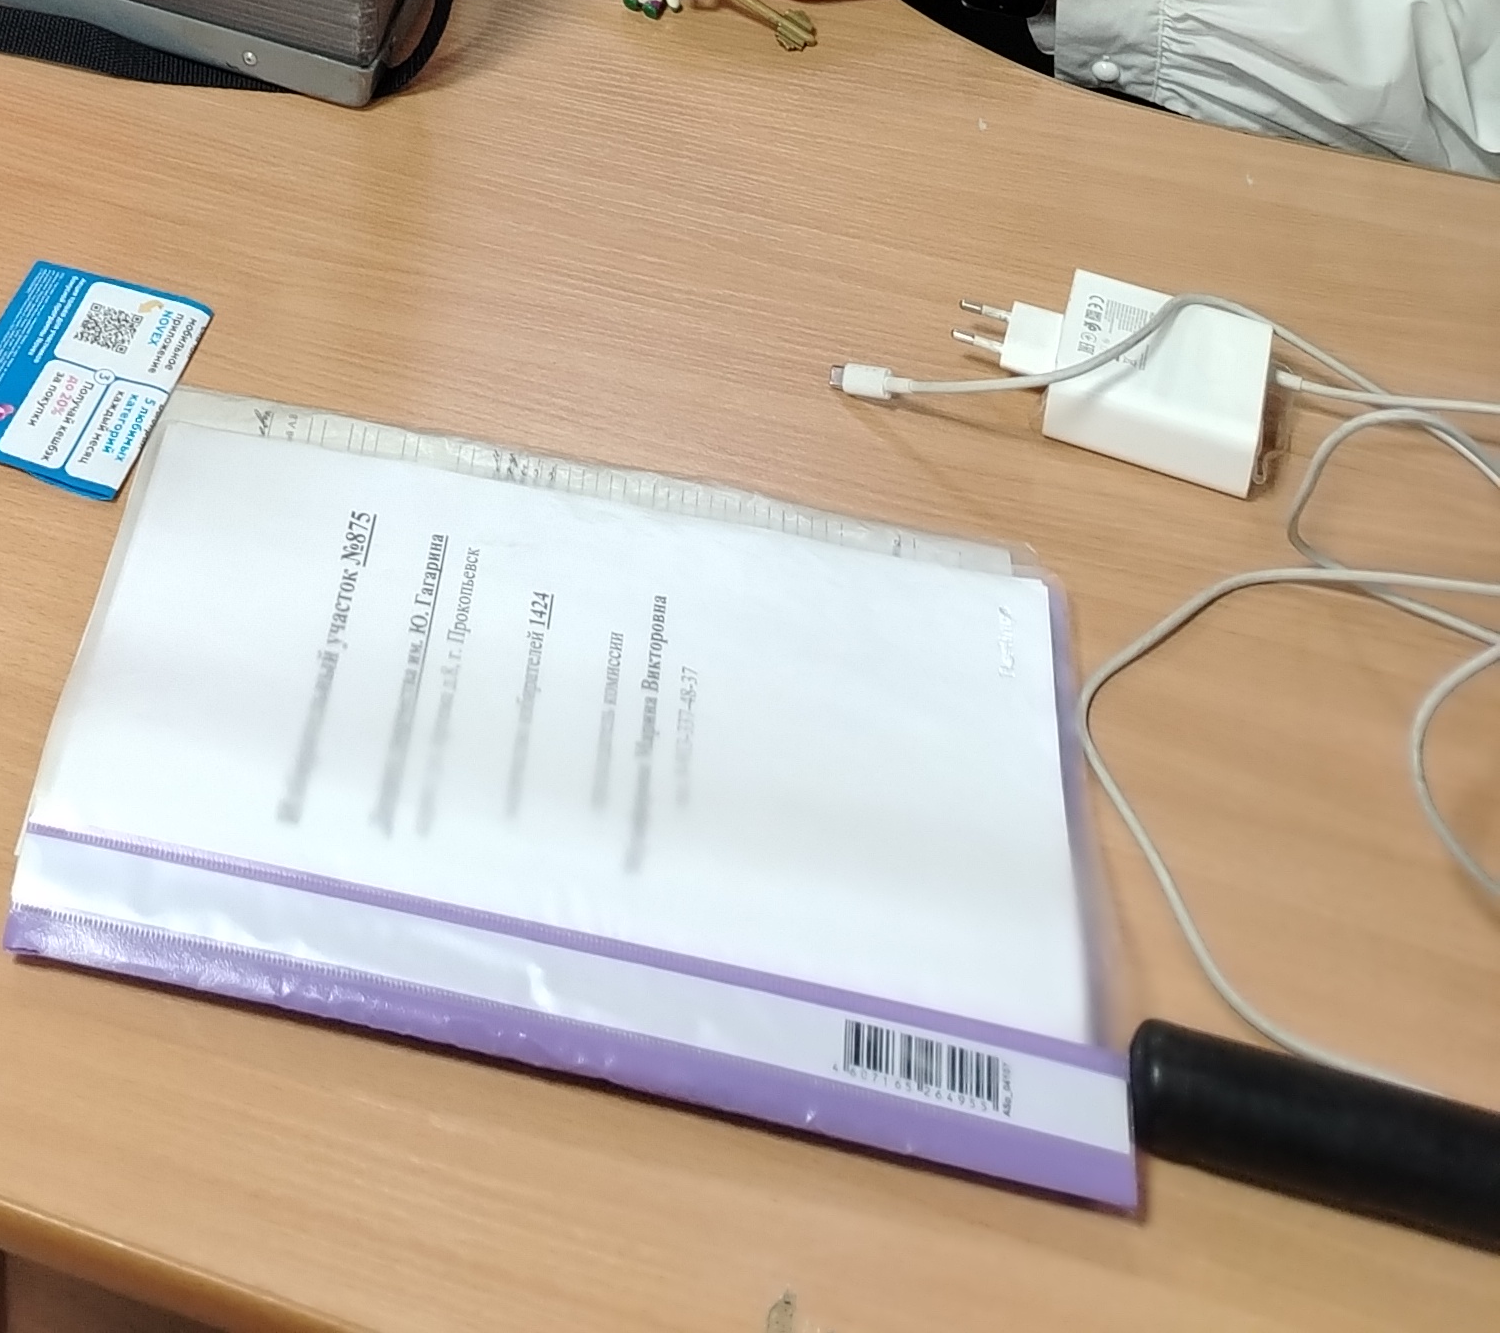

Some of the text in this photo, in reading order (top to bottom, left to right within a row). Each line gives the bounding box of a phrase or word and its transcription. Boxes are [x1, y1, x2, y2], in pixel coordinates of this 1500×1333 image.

[148, 309, 174, 346] NOVEX
[148, 313, 184, 373] приложение
[164, 317, 197, 370] мобильное
[27, 371, 65, 427] за покупки
[51, 374, 79, 416] до 20%
[99, 372, 110, 381] 3
[41, 381, 95, 462] Получай кешбэк
[78, 390, 125, 464] каждый месяц
[102, 393, 139, 453] категорий
[115, 397, 156, 462] 5 любимых
[325, 511, 374, 649] участок №875
[407, 533, 446, 666] им. Ю. Гагарина
[447, 545, 481, 646] Прокопьевск
[529, 590, 551, 628] 1424
[603, 631, 624, 706] комиссии
[641, 594, 668, 694] Викторовна
